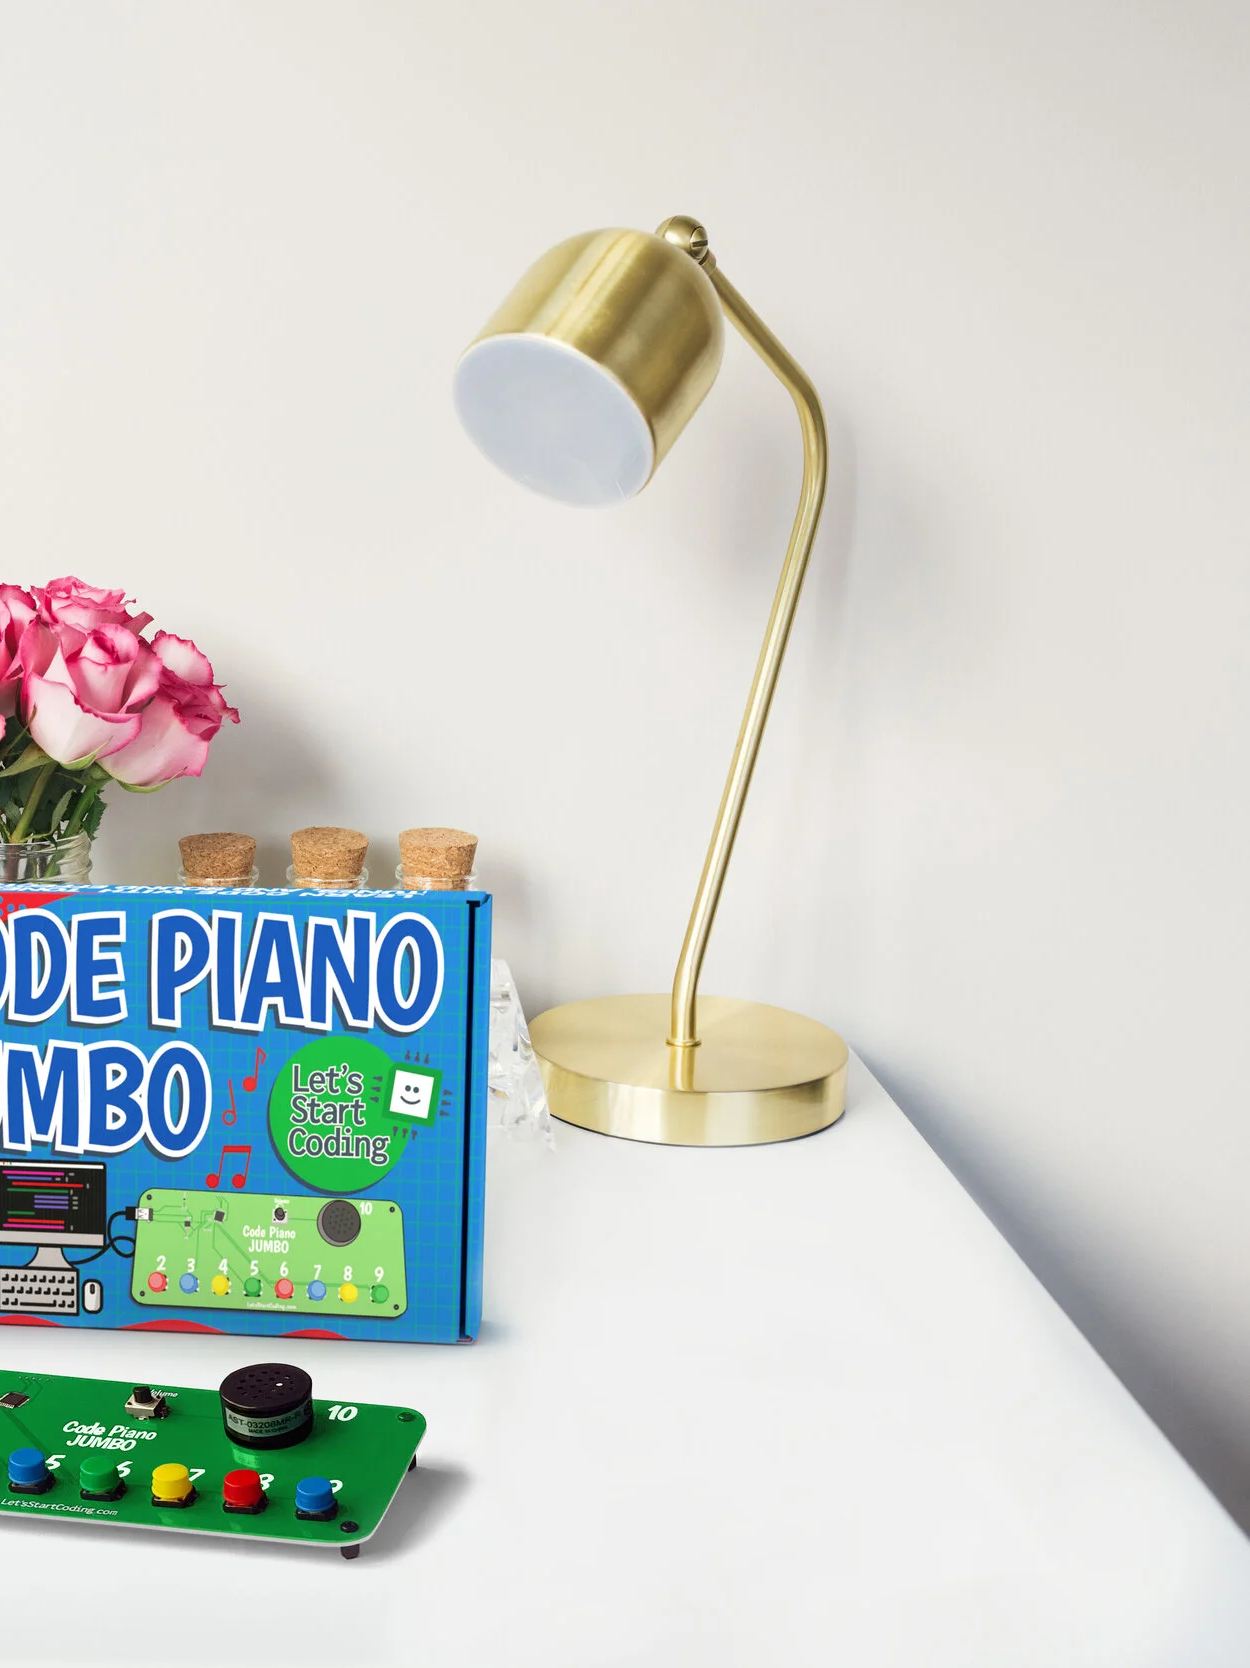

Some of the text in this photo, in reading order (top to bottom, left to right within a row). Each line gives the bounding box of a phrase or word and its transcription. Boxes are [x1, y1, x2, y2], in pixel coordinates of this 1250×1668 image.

[150, 909, 445, 1033] PIANO
[292, 1063, 364, 1095] Let's
[290, 1094, 366, 1125] Start
[288, 1126, 390, 1166] Coding
[359, 1202, 373, 1216] 10
[242, 1225, 296, 1240] Code Piano
[248, 1239, 289, 1254] JUMBO
[156, 1255, 384, 1282] 2 3 4 5 6 7 8 9
[149, 1389, 178, 1398] olume
[327, 1405, 358, 1422] 10
[63, 1420, 157, 1441] Code Piano
[66, 1435, 136, 1451] JUMBO
[45, 1454, 66, 1470] 5
[188, 1468, 206, 1482] 7
